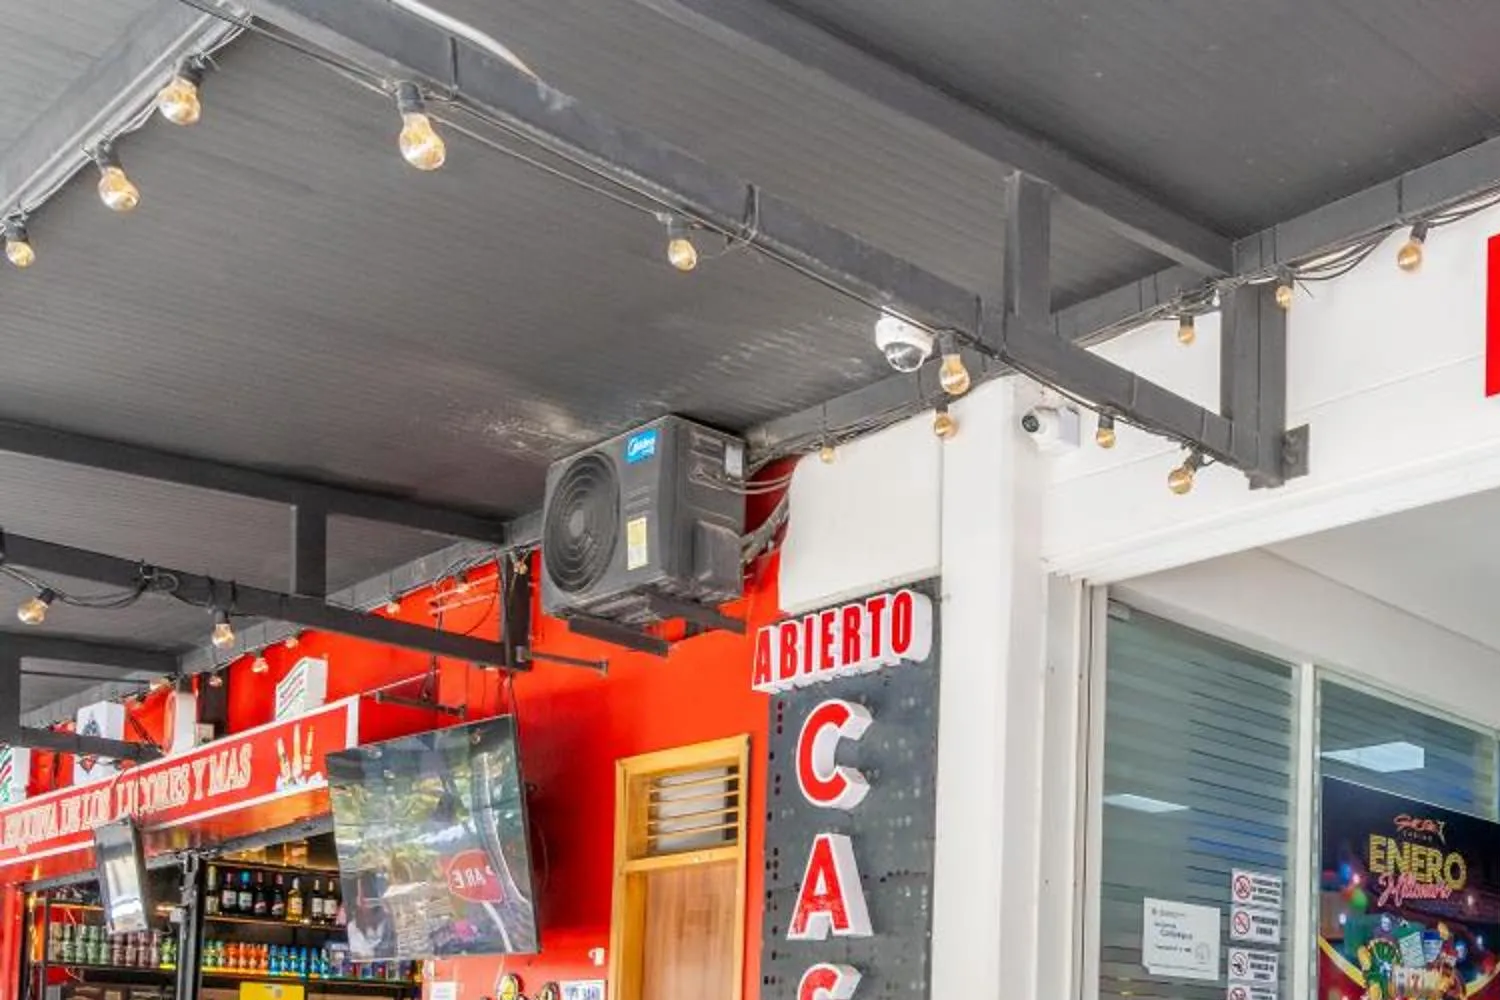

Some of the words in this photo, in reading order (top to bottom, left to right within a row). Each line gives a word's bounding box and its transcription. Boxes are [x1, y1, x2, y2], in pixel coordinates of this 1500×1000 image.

[752, 589, 926, 692] ABIERTO
[189, 757, 209, 801] Y
[208, 744, 253, 798] MAS
[1369, 834, 1467, 892] ENERO
